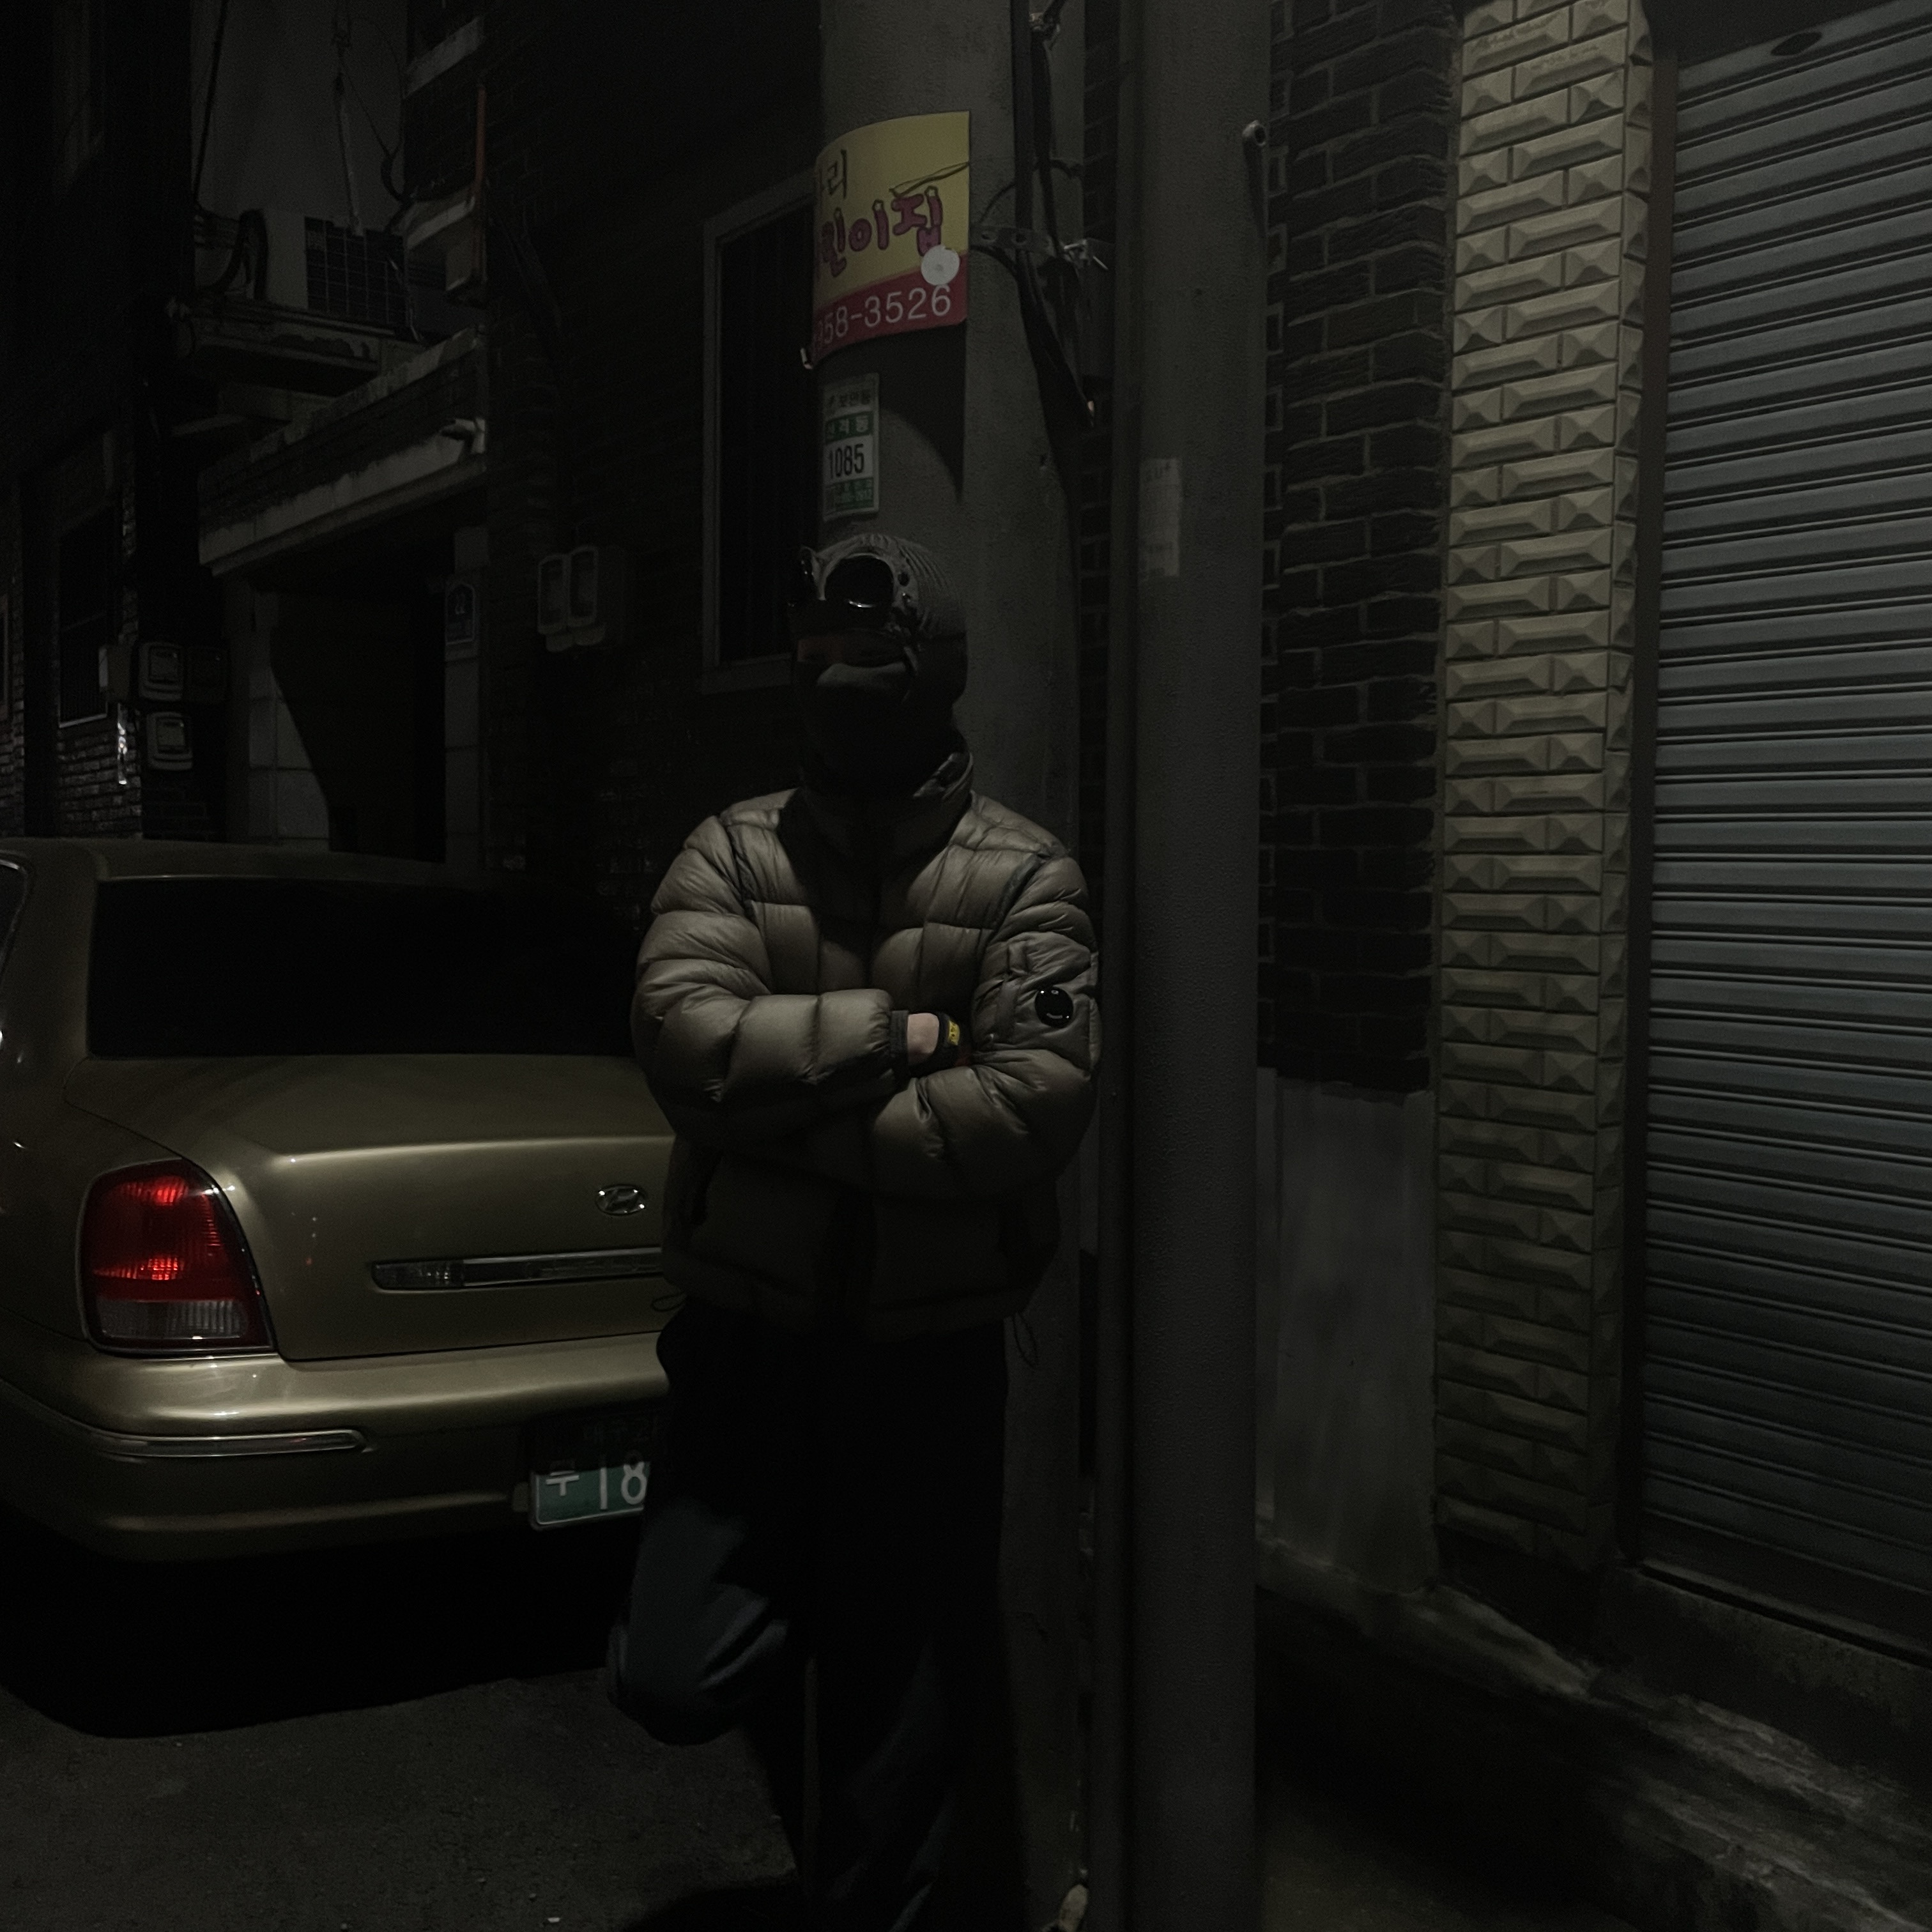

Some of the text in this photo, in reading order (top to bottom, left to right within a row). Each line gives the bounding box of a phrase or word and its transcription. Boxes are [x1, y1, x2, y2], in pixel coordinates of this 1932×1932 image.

[816, 185, 943, 277] 린이집
[829, 443, 864, 479] 1085
[599, 1449, 648, 1510] 18
